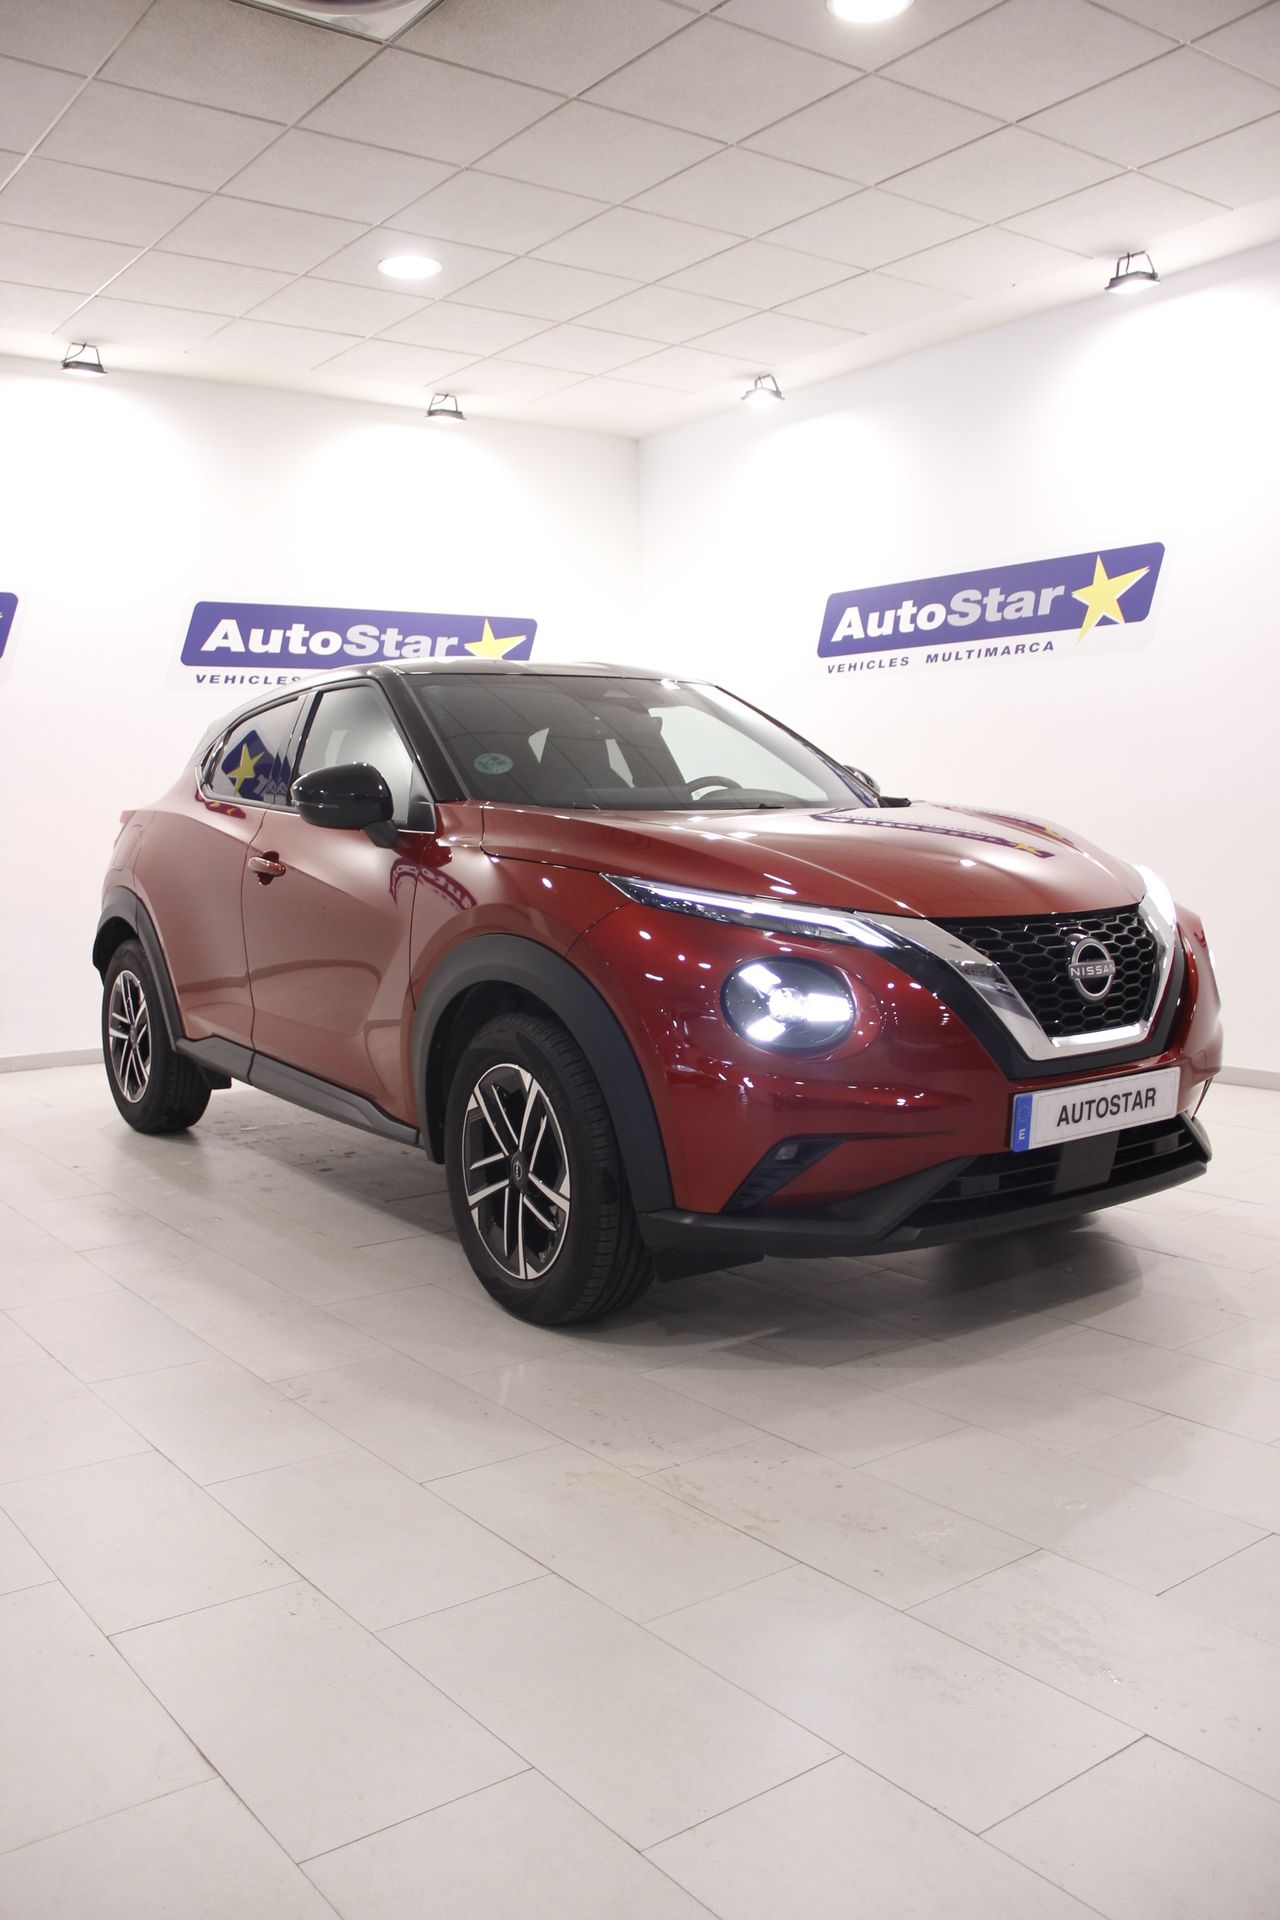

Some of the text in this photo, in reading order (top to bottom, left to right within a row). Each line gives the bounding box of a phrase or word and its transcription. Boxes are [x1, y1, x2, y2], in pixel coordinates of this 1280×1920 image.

[832, 585, 1065, 642] AutoStar
[200, 618, 459, 658] AutoStar
[827, 641, 1055, 674] VEHICLES MULTIMARCA
[1056, 1087, 1157, 1127] AUTOSTAR
[1018, 1128, 1026, 1140] E
